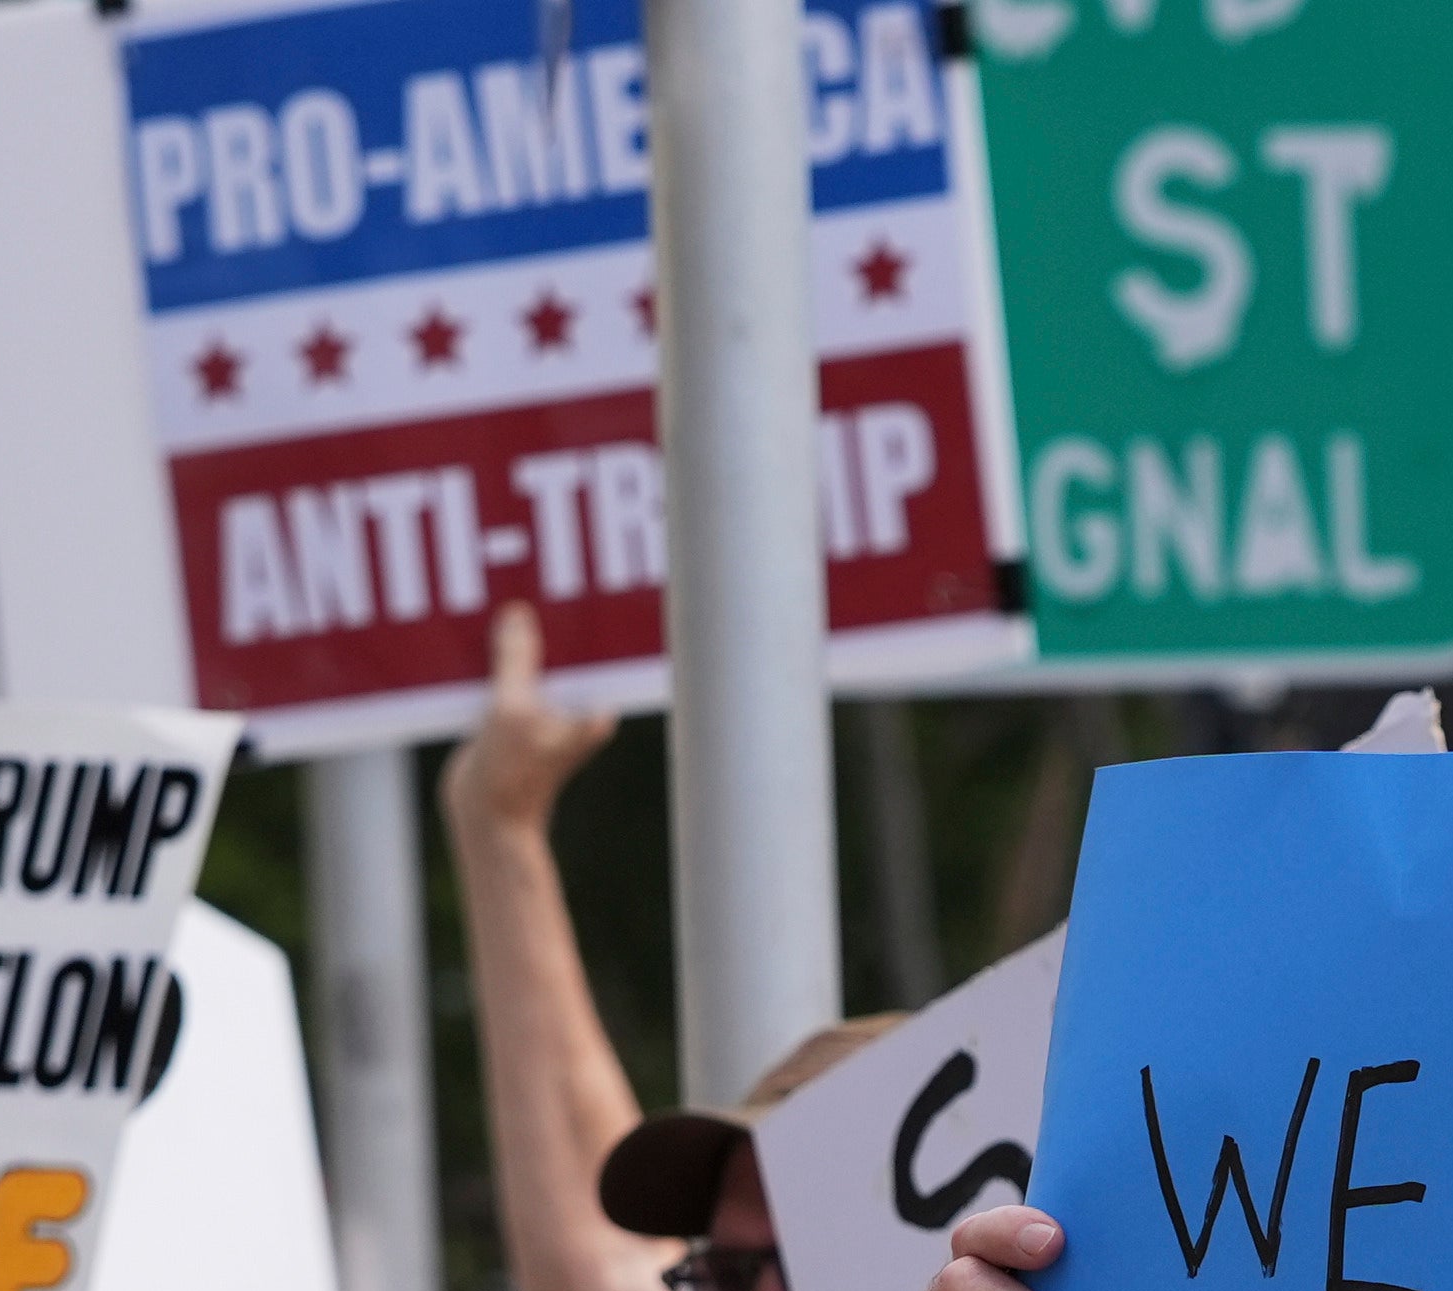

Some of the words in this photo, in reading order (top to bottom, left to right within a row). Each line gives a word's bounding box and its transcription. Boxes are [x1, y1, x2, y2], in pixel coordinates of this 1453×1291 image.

[131, 4, 941, 264] PRO-AMECA
[1109, 122, 1395, 370] ST
[219, 402, 936, 648] ANTI-TRP
